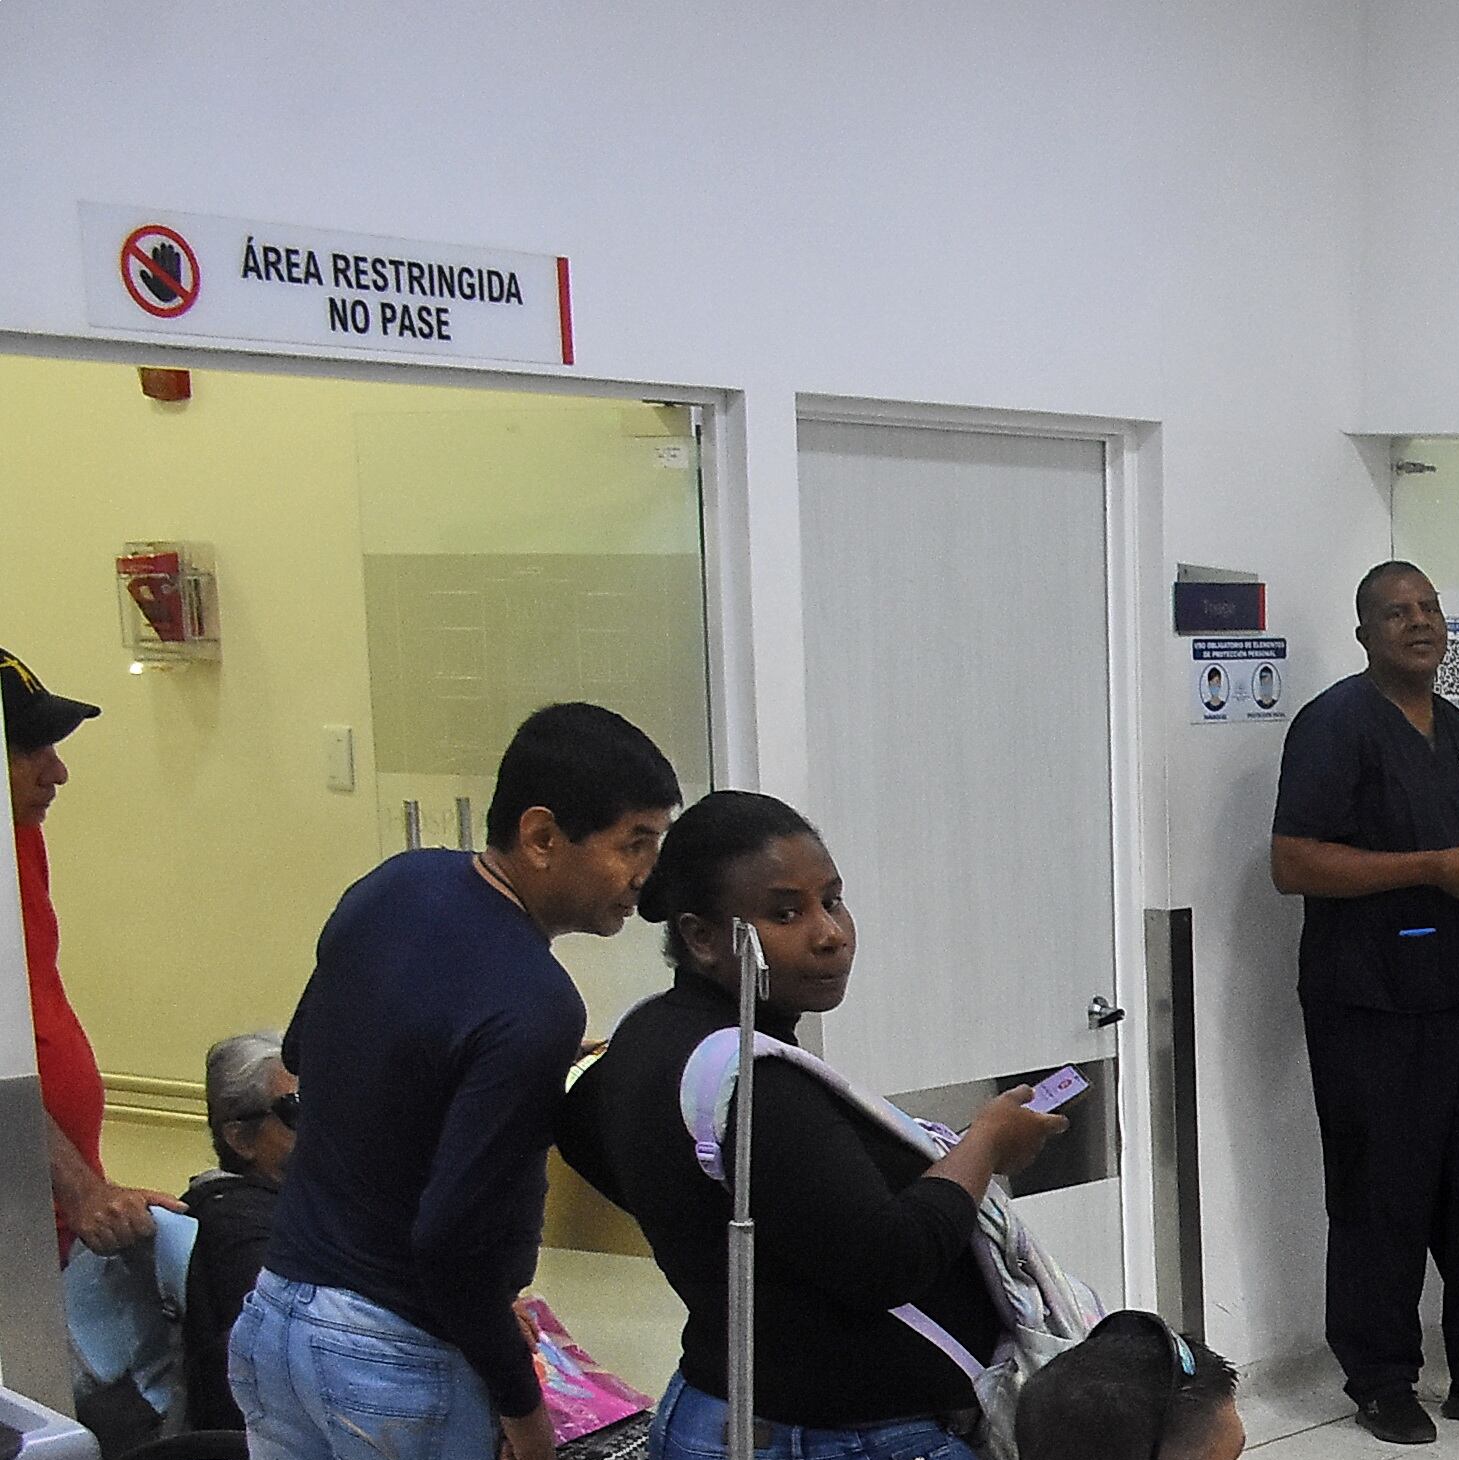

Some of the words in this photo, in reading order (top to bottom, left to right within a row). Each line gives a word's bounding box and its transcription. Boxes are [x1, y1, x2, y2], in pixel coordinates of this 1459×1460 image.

[242, 236, 323, 285] ÁREA
[333, 253, 523, 305] RESTRINGIDA
[329, 297, 370, 333] NO
[380, 302, 452, 340] PASE
